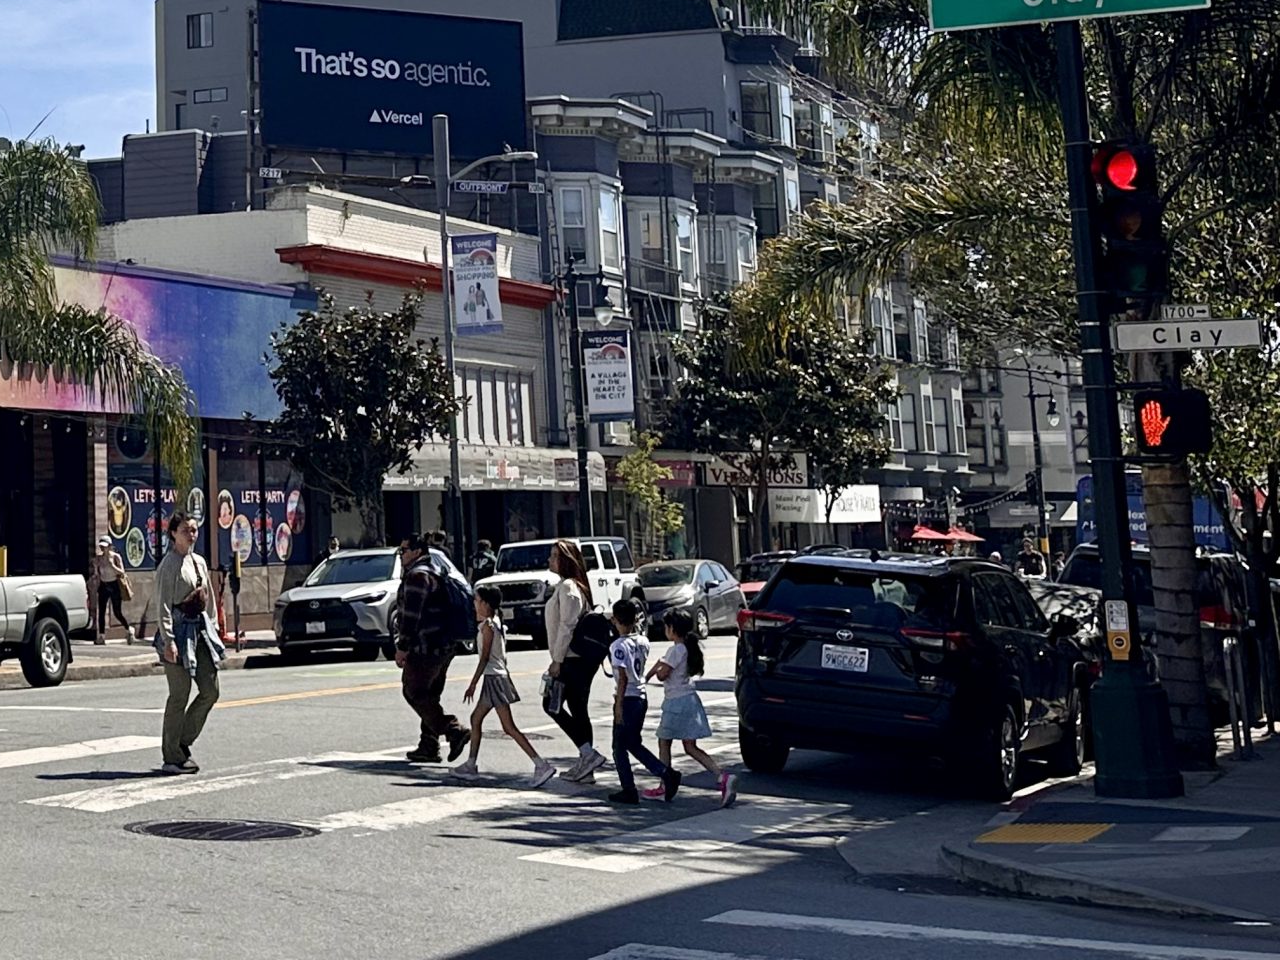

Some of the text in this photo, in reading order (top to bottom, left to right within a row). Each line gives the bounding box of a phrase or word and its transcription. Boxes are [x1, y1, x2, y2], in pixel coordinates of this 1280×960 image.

[294, 47, 490, 87] That's so agentic.
[381, 110, 423, 125] Vercel
[459, 182, 503, 192] OUTFRONT
[456, 240, 492, 249] WELCOME
[456, 271, 495, 281] SHOPPING
[1164, 307, 1194, 318] 1700
[588, 336, 624, 344] WELCOME
[1152, 326, 1223, 346] Clay
[134, 489, 155, 503] LET'S
[241, 490, 260, 504] LET'S
